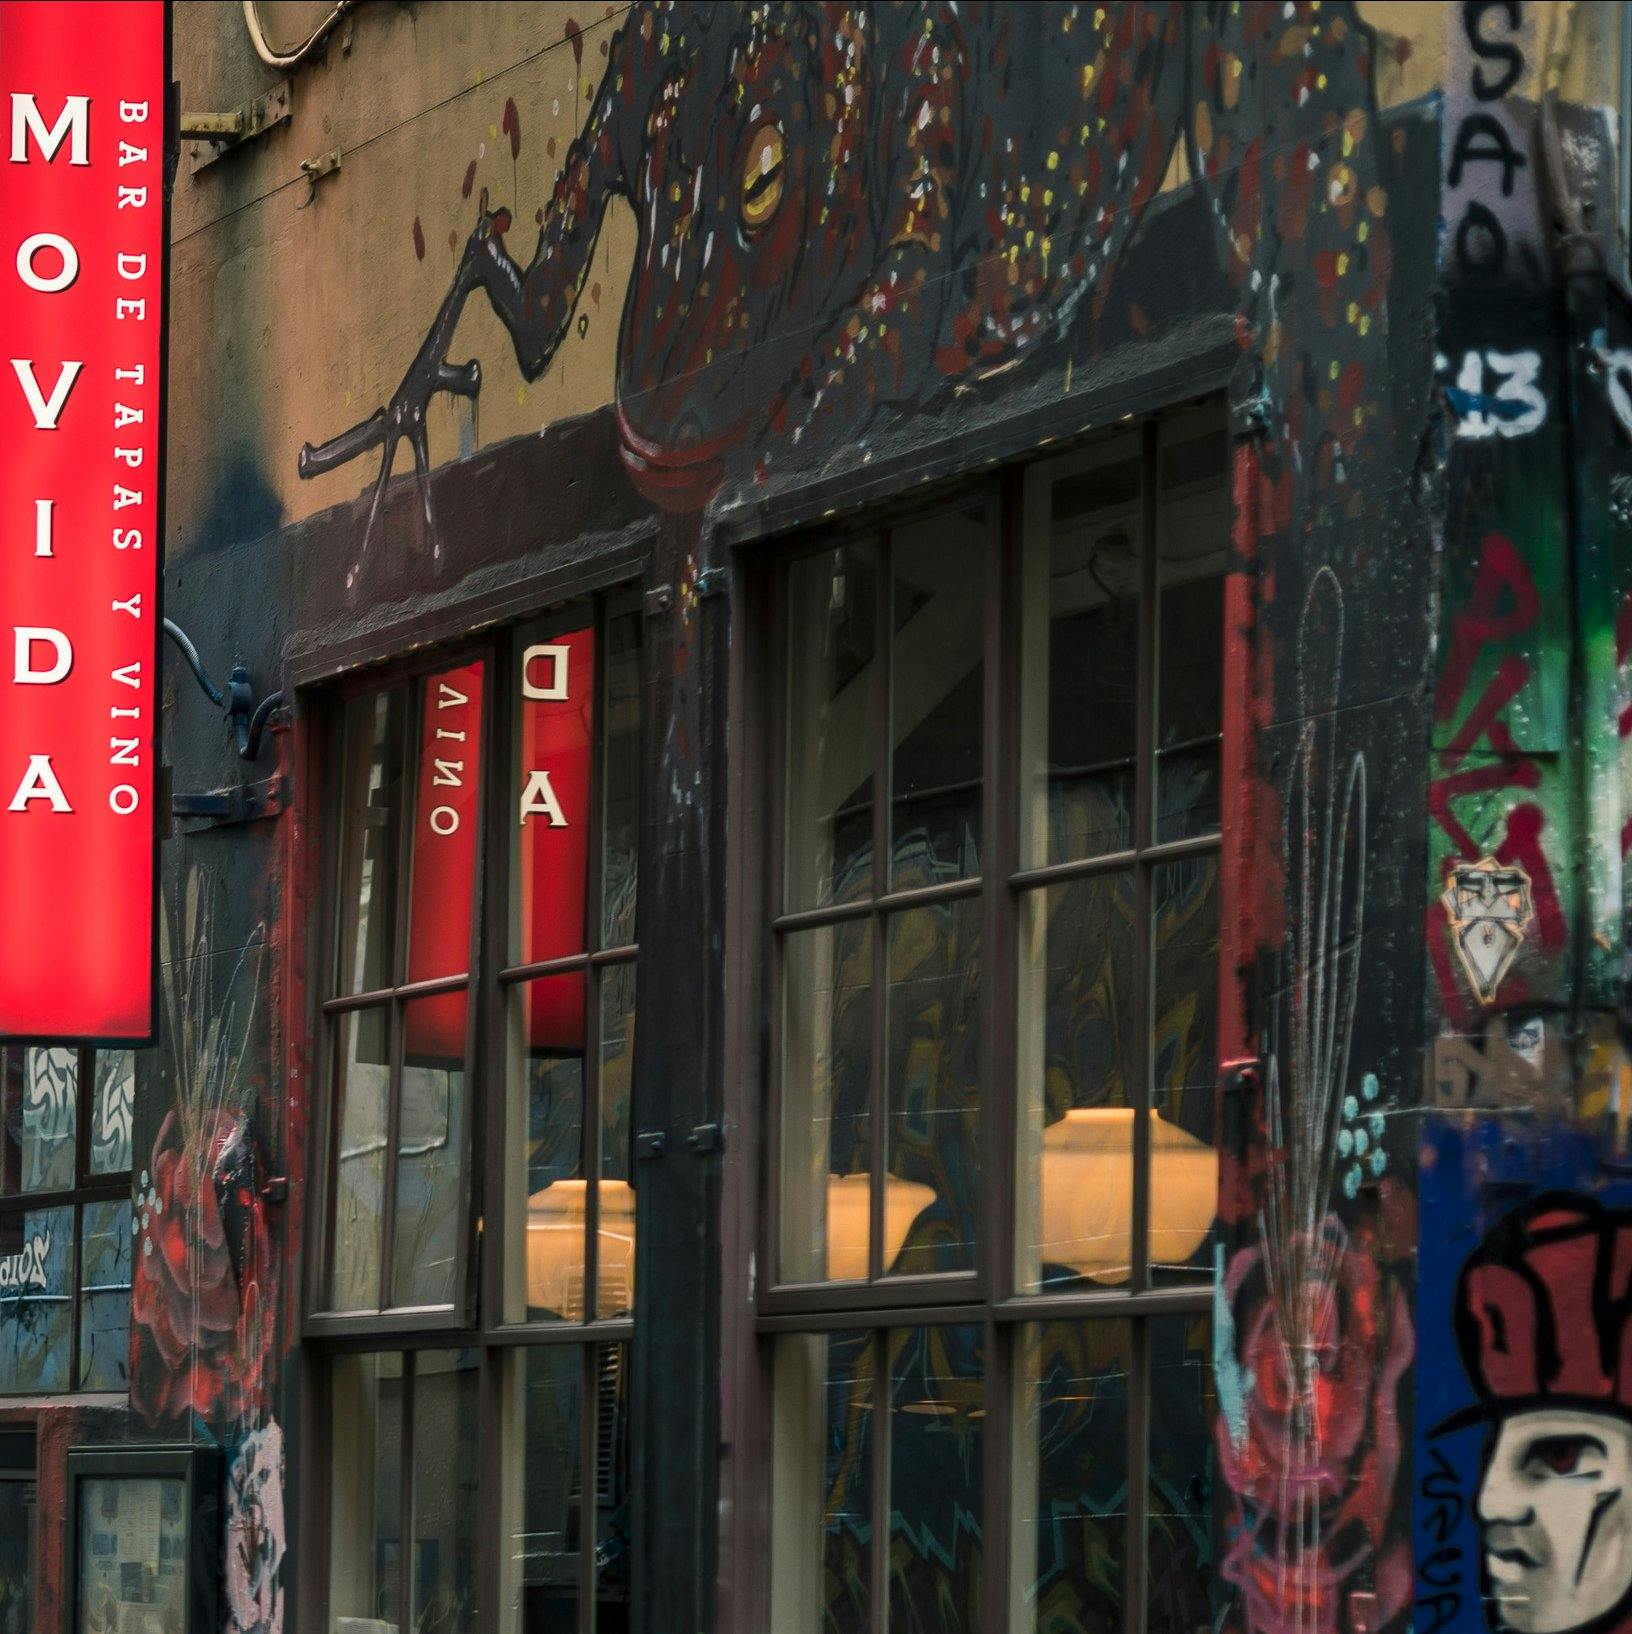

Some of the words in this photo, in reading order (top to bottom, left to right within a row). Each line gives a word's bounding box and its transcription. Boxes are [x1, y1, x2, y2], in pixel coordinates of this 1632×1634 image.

[118, 100, 149, 209] BAR
[116, 252, 147, 321] DE
[8, 93, 90, 813] MOVIDA
[112, 364, 144, 550] TAPAS
[111, 593, 141, 619] Y
[108, 661, 141, 815] VINO
